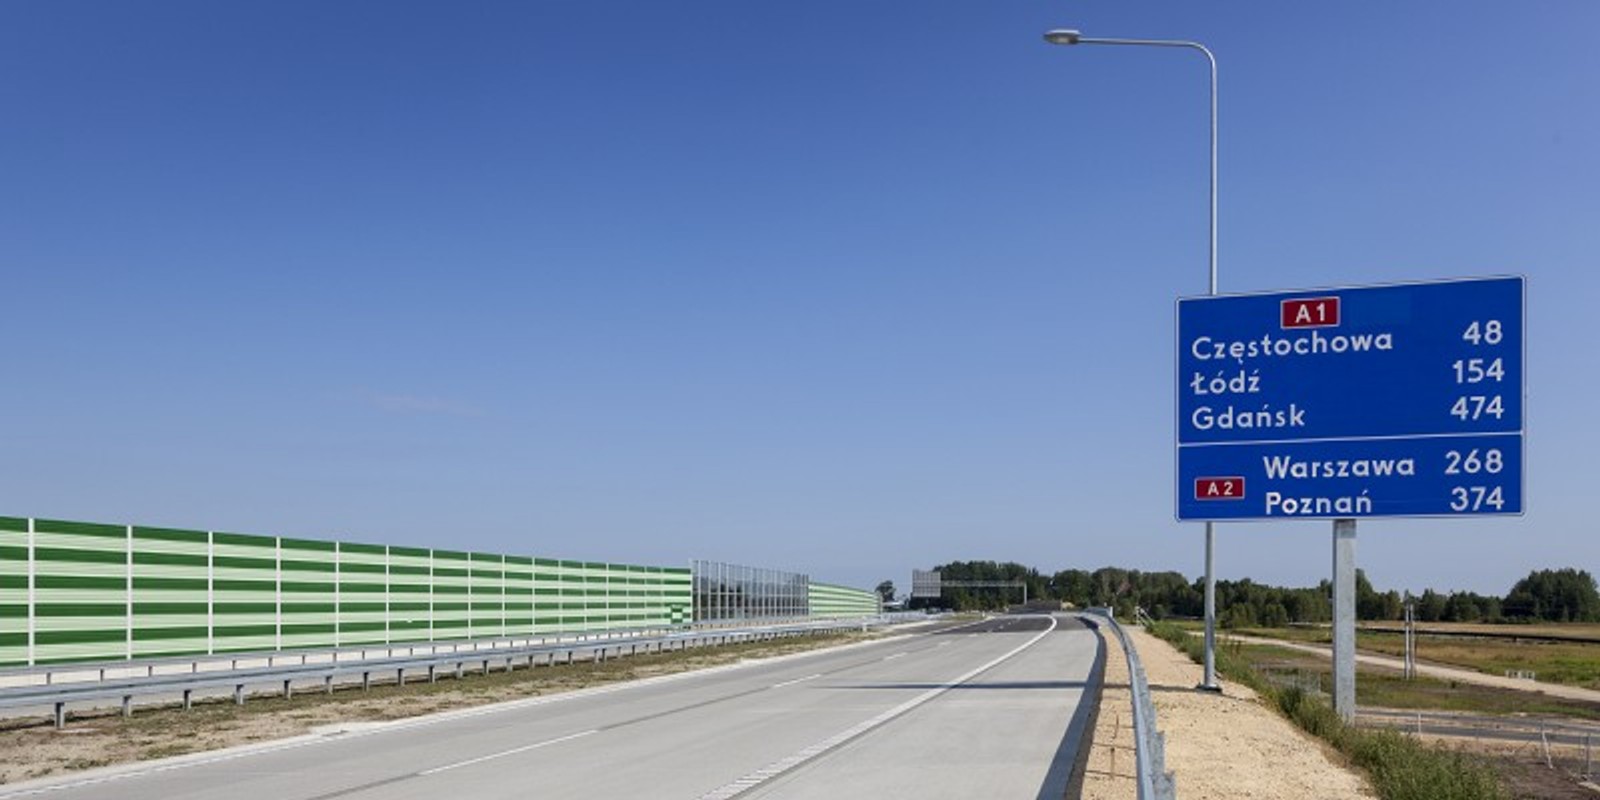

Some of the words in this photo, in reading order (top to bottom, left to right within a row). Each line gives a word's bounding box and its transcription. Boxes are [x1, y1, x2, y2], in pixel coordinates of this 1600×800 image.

[1192, 331, 1392, 363] Częstochowa
[1463, 320, 1503, 344] 48
[1190, 369, 1260, 395] Łódź
[1453, 358, 1505, 383] 154
[1192, 404, 1305, 430] Gdańsk
[1451, 396, 1505, 420] 474
[1263, 456, 1415, 479] Warszawa
[1445, 450, 1503, 473] 268
[1266, 490, 1371, 514] Poznań
[1451, 487, 1505, 510] 374
